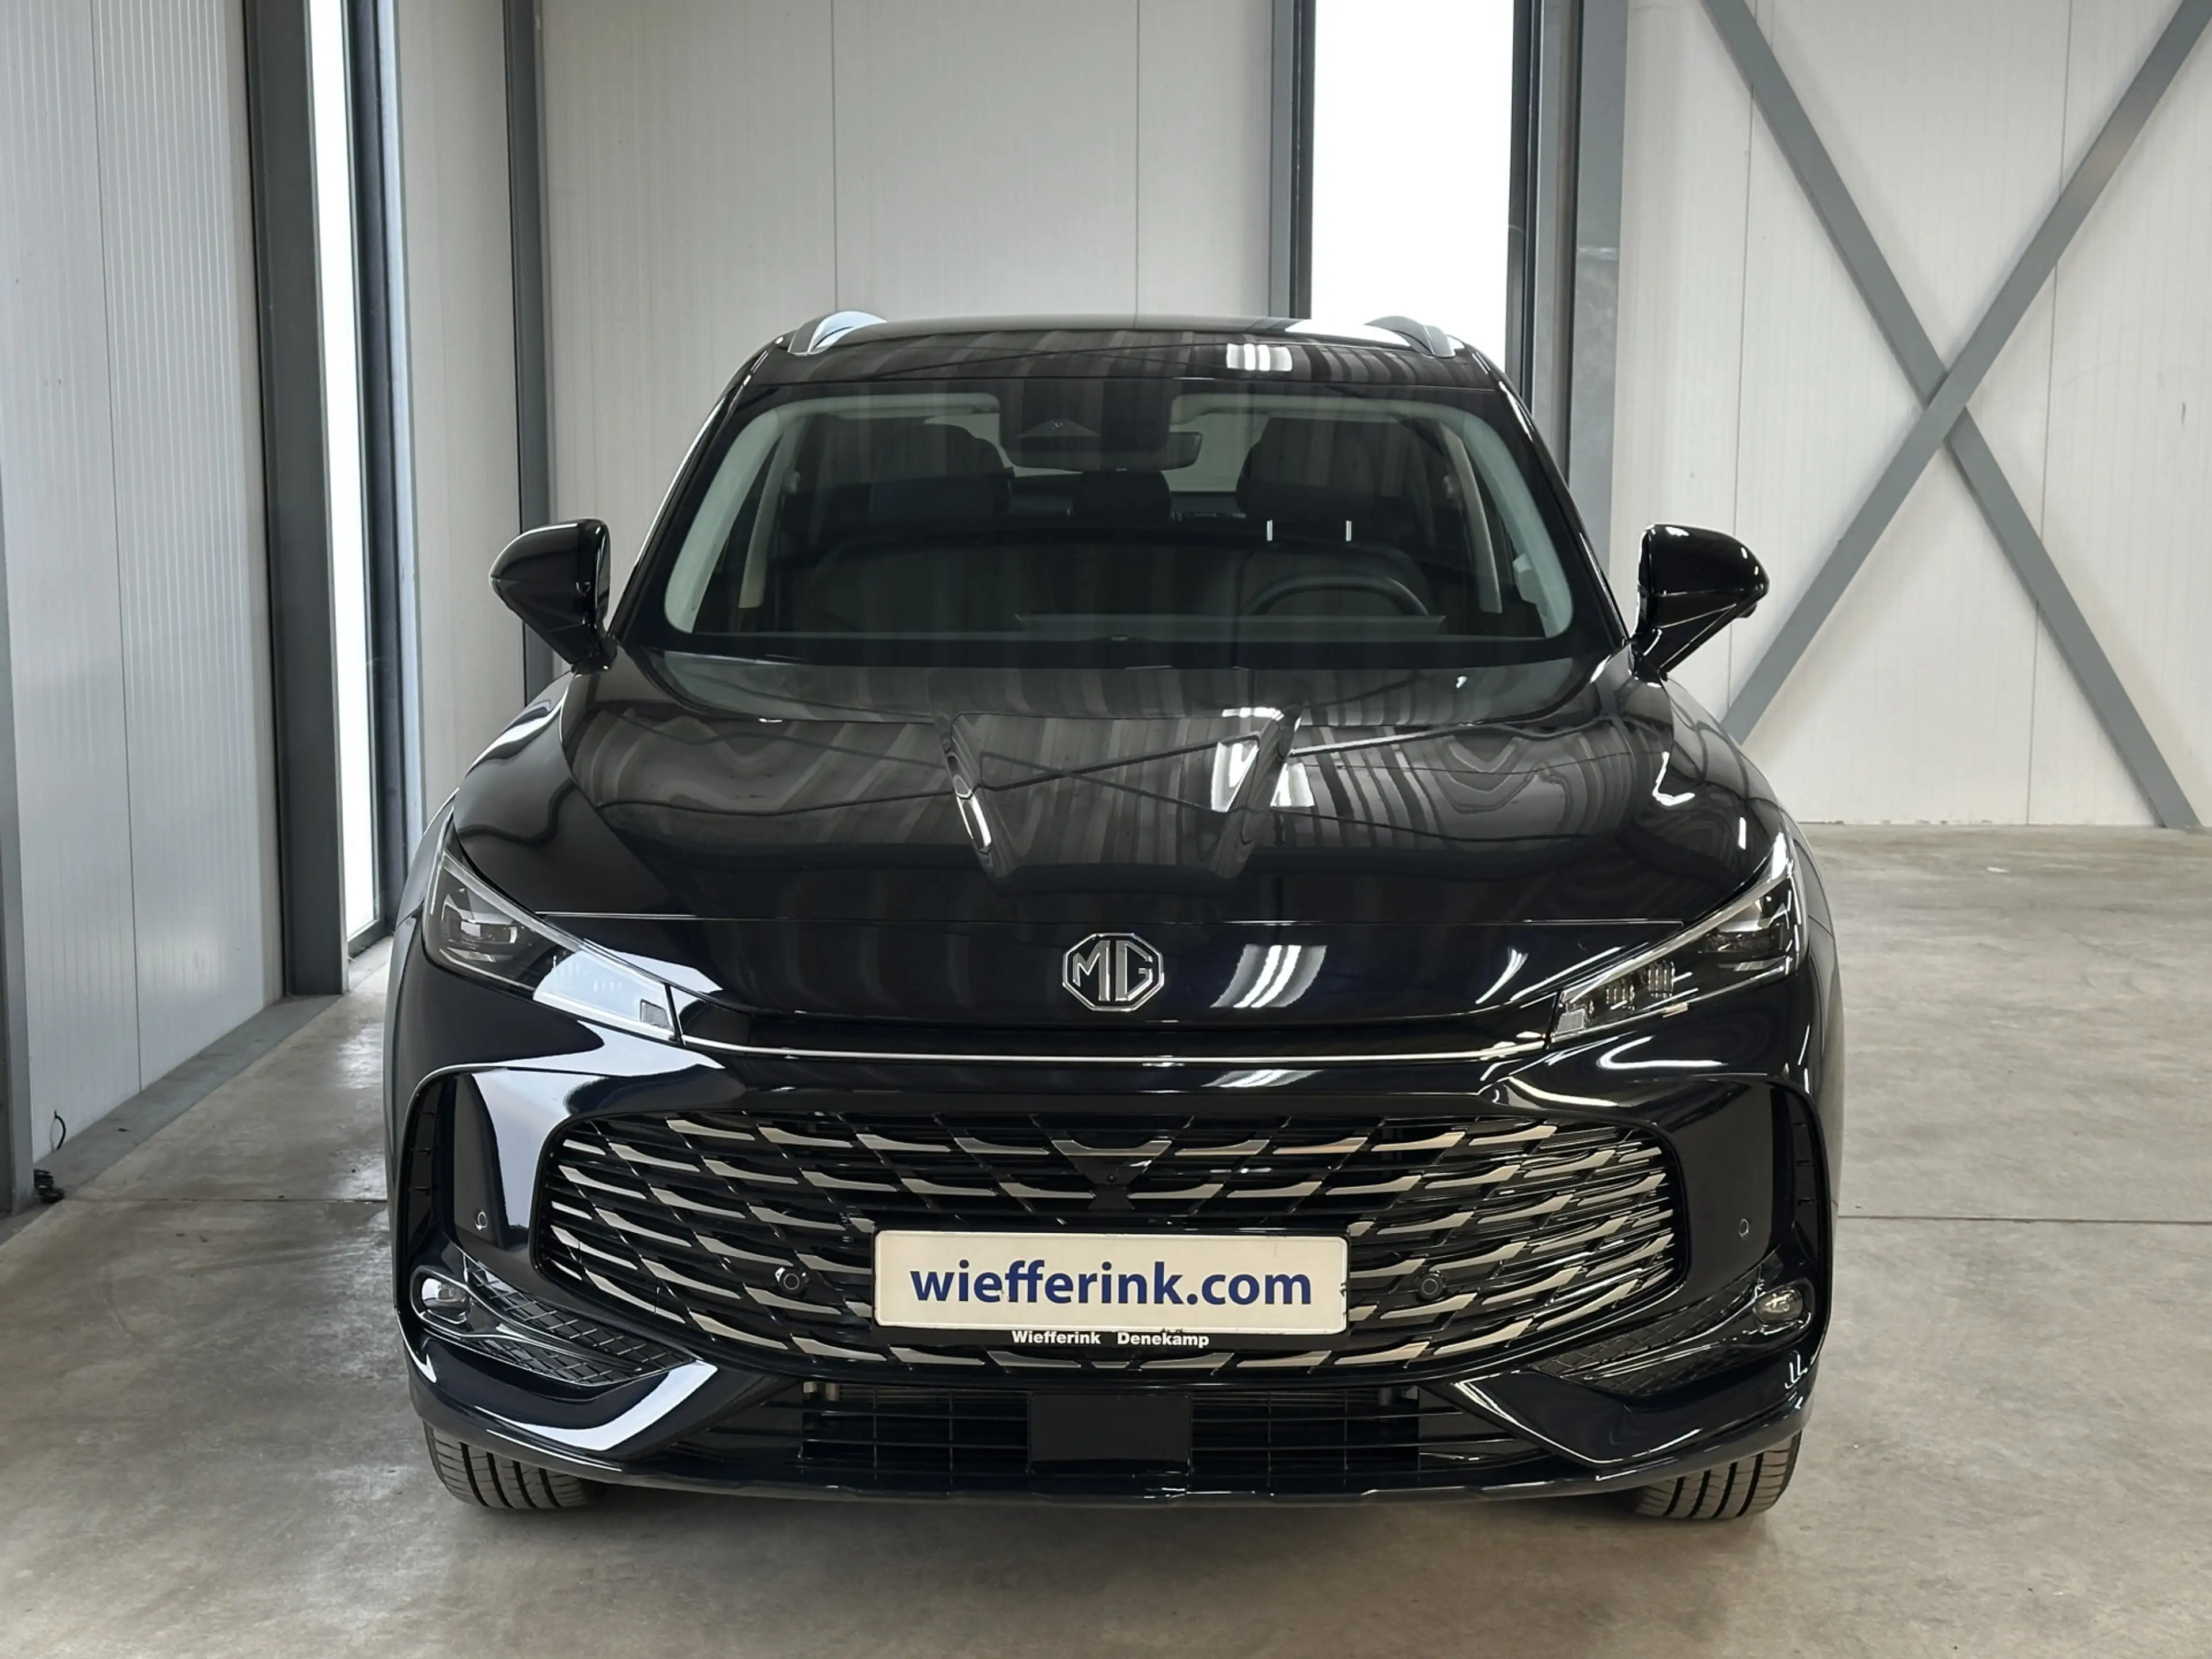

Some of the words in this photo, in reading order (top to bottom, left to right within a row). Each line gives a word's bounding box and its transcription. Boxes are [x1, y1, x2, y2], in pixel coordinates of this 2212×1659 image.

[1072, 940, 1153, 1002] MG
[910, 1259, 1311, 1306] wiefferink.com
[1012, 1330, 1101, 1344] Wiefferink
[1118, 1331, 1210, 1349] Denekamp
